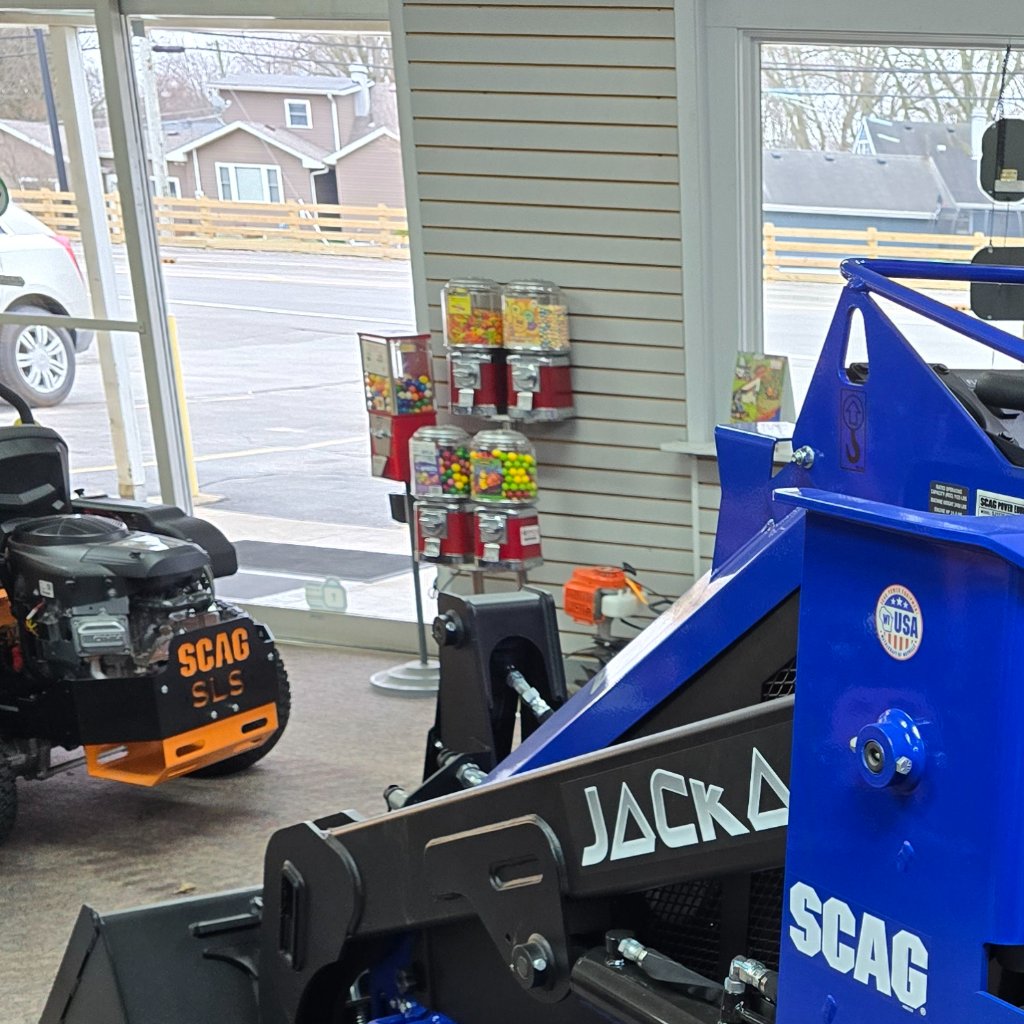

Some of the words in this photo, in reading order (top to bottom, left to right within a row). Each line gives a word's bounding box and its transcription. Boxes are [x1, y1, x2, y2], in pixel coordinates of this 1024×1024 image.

[980, 497, 997, 509] SCAG
[997, 502, 1013, 513] POWER
[894, 611, 918, 639] USA
[177, 627, 250, 678] SCAG
[192, 669, 244, 708] SLS
[581, 747, 791, 867] JACKA
[789, 881, 929, 1010] SCAG
